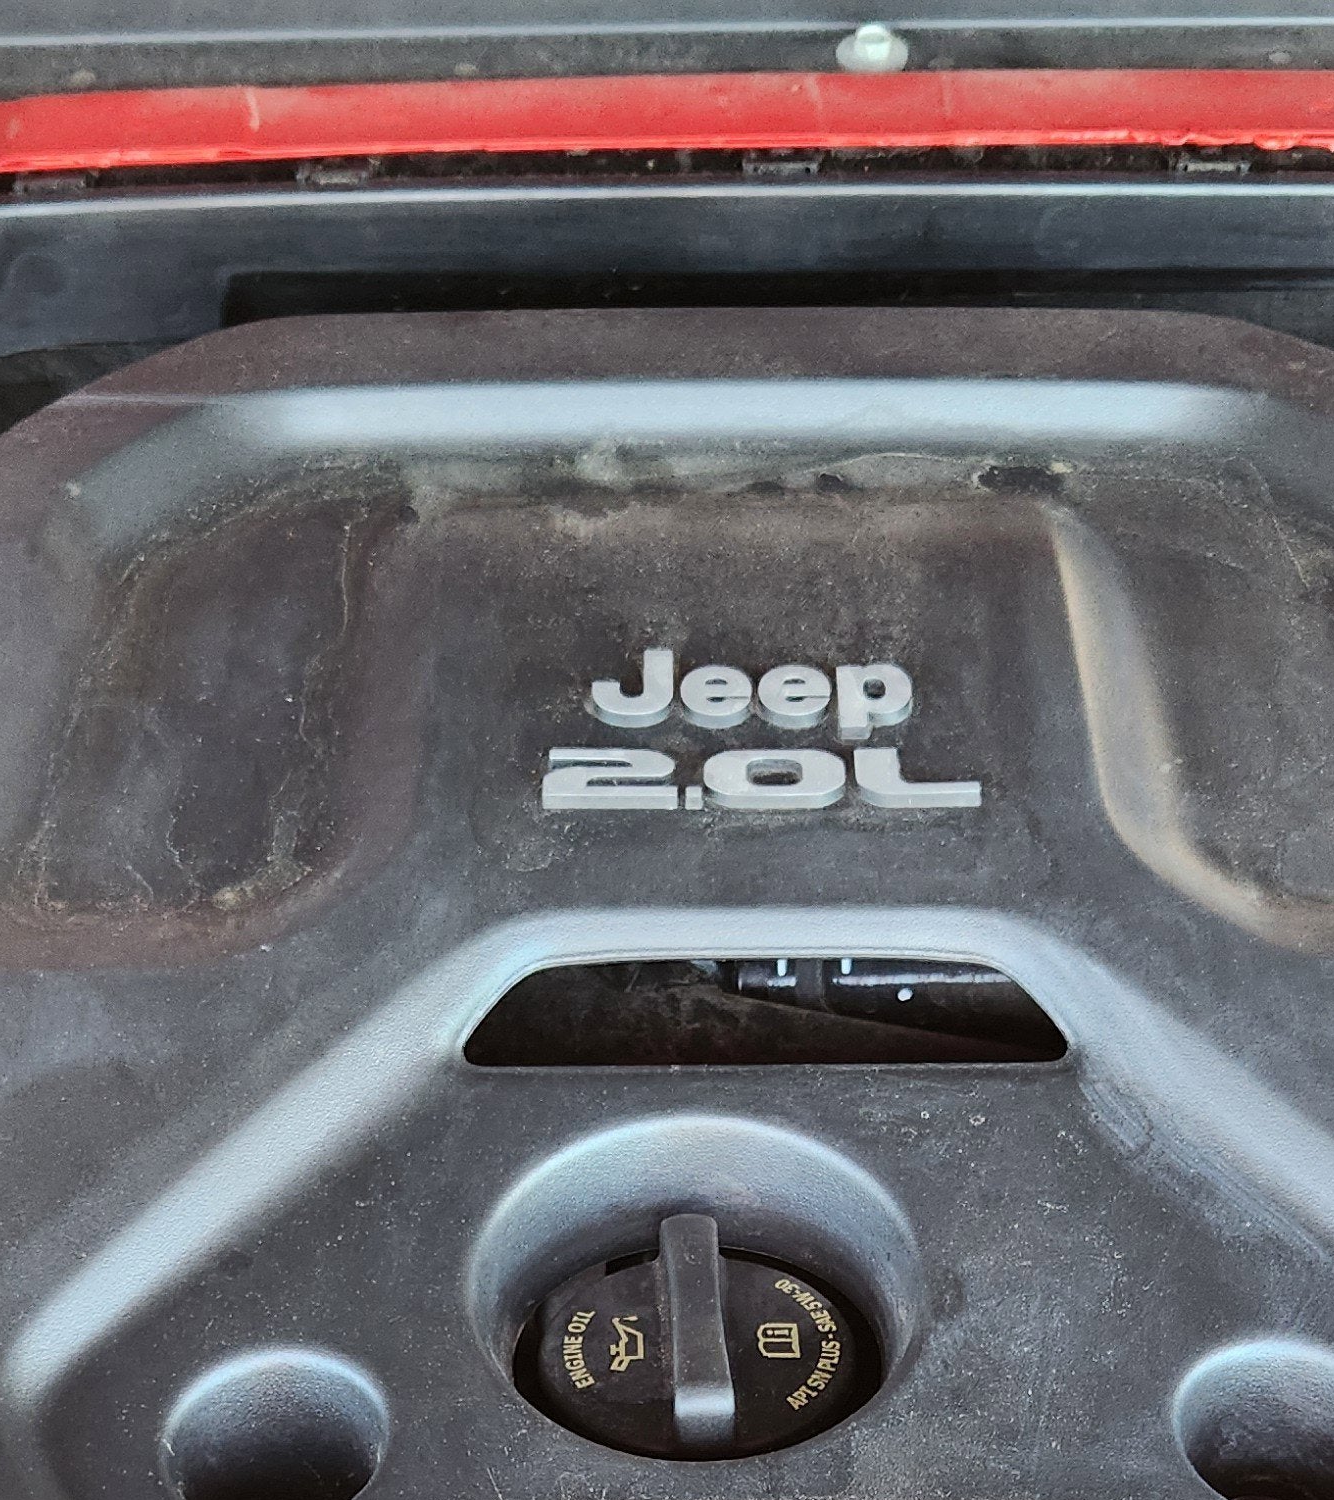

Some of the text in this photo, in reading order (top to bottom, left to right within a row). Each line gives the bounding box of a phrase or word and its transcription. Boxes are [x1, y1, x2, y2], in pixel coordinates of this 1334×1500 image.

[590, 647, 913, 741] Jeep
[541, 747, 982, 810] 2.0L
[562, 1310, 597, 1389] ENGINE OIL
[816, 1340, 841, 1372] PLUS
[786, 1384, 819, 1410] API
[806, 1370, 833, 1391] SN
